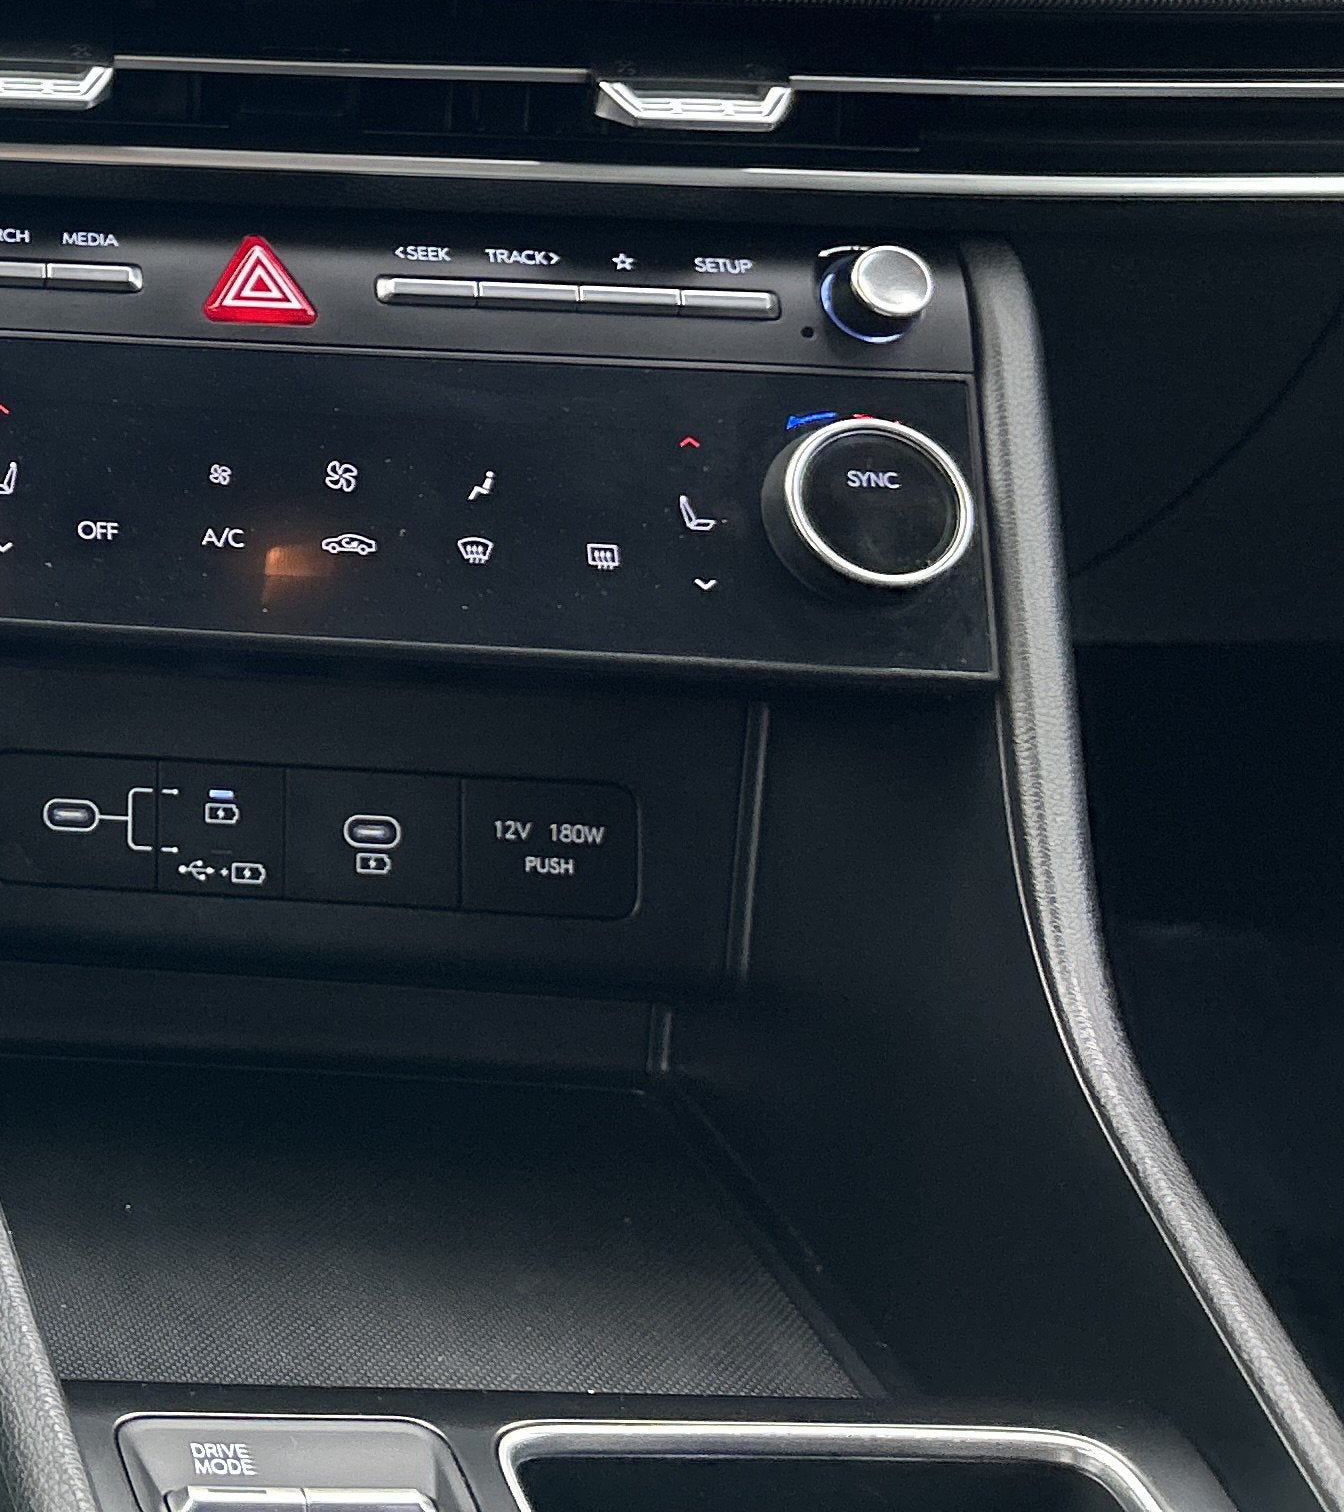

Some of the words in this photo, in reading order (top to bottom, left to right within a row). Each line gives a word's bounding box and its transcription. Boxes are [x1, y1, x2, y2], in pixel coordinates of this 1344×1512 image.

[62, 232, 118, 248] MEDIA
[694, 257, 752, 275] SETUP
[847, 470, 899, 489] SYNC
[77, 521, 118, 541] OFF
[202, 527, 245, 549] A/C
[494, 820, 531, 840] 12V
[549, 823, 604, 845] 180W
[524, 856, 574, 874] PUSH
[191, 1443, 249, 1459] DRIVE
[194, 1459, 255, 1476] MODE
